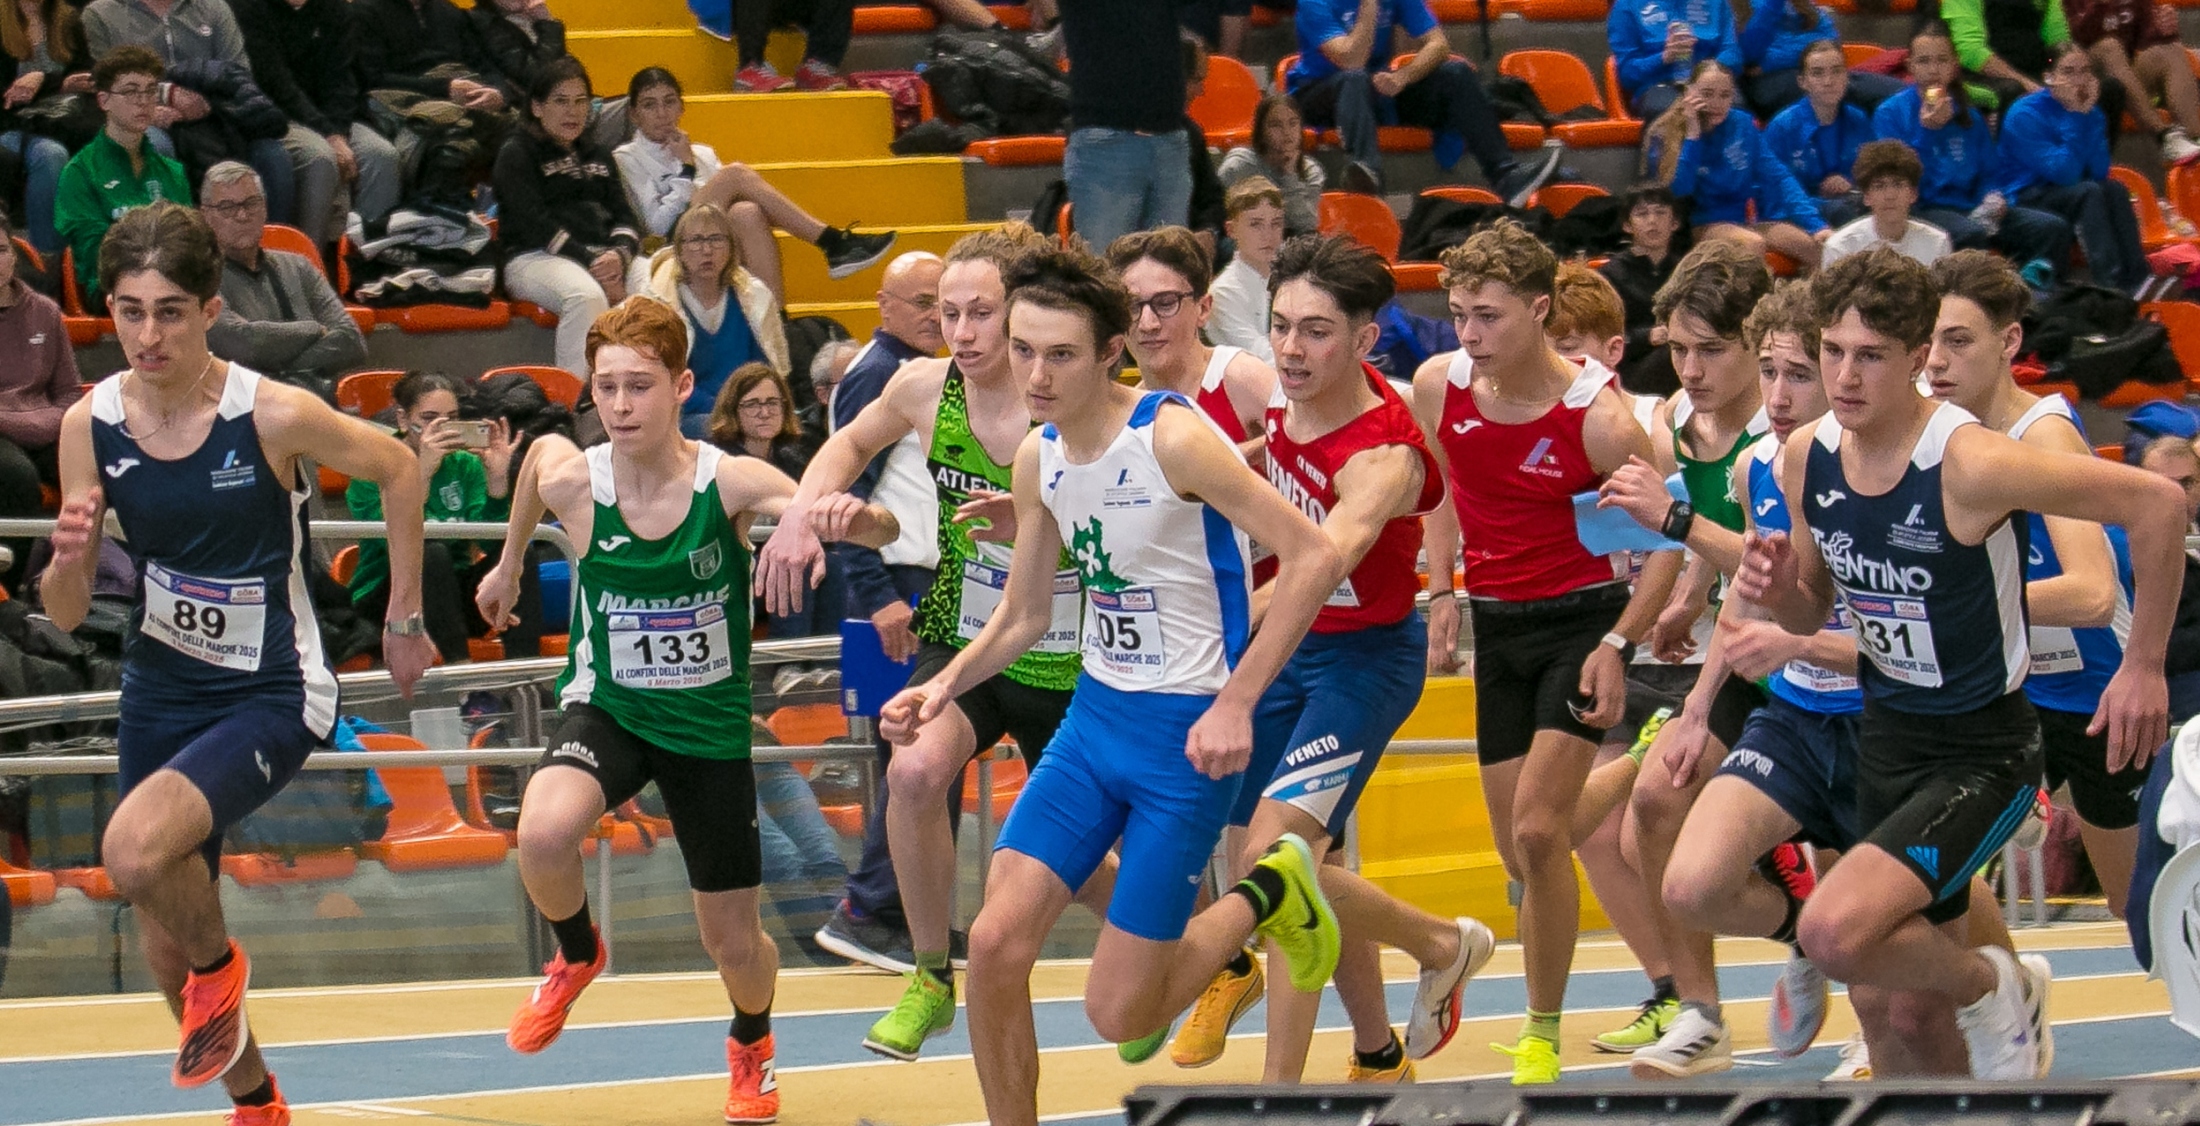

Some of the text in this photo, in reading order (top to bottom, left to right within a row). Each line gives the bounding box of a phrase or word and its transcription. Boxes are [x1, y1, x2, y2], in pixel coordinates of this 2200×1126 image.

[173, 599, 226, 640] 89
[182, 633, 205, 649] DELLE
[206, 640, 238, 656] MARCHE
[238, 645, 258, 658] 2025
[1058, 630, 1077, 641] 2025
[633, 631, 711, 666] 133
[1114, 653, 1143, 664] MARCHE
[1144, 654, 1162, 666] 2025
[615, 656, 729, 679] AI CONFINI DELLE MARCHE 2025
[654, 678, 681, 687] Marzo
[682, 676, 703, 685] 2025
[1285, 734, 1339, 767] VENETO
